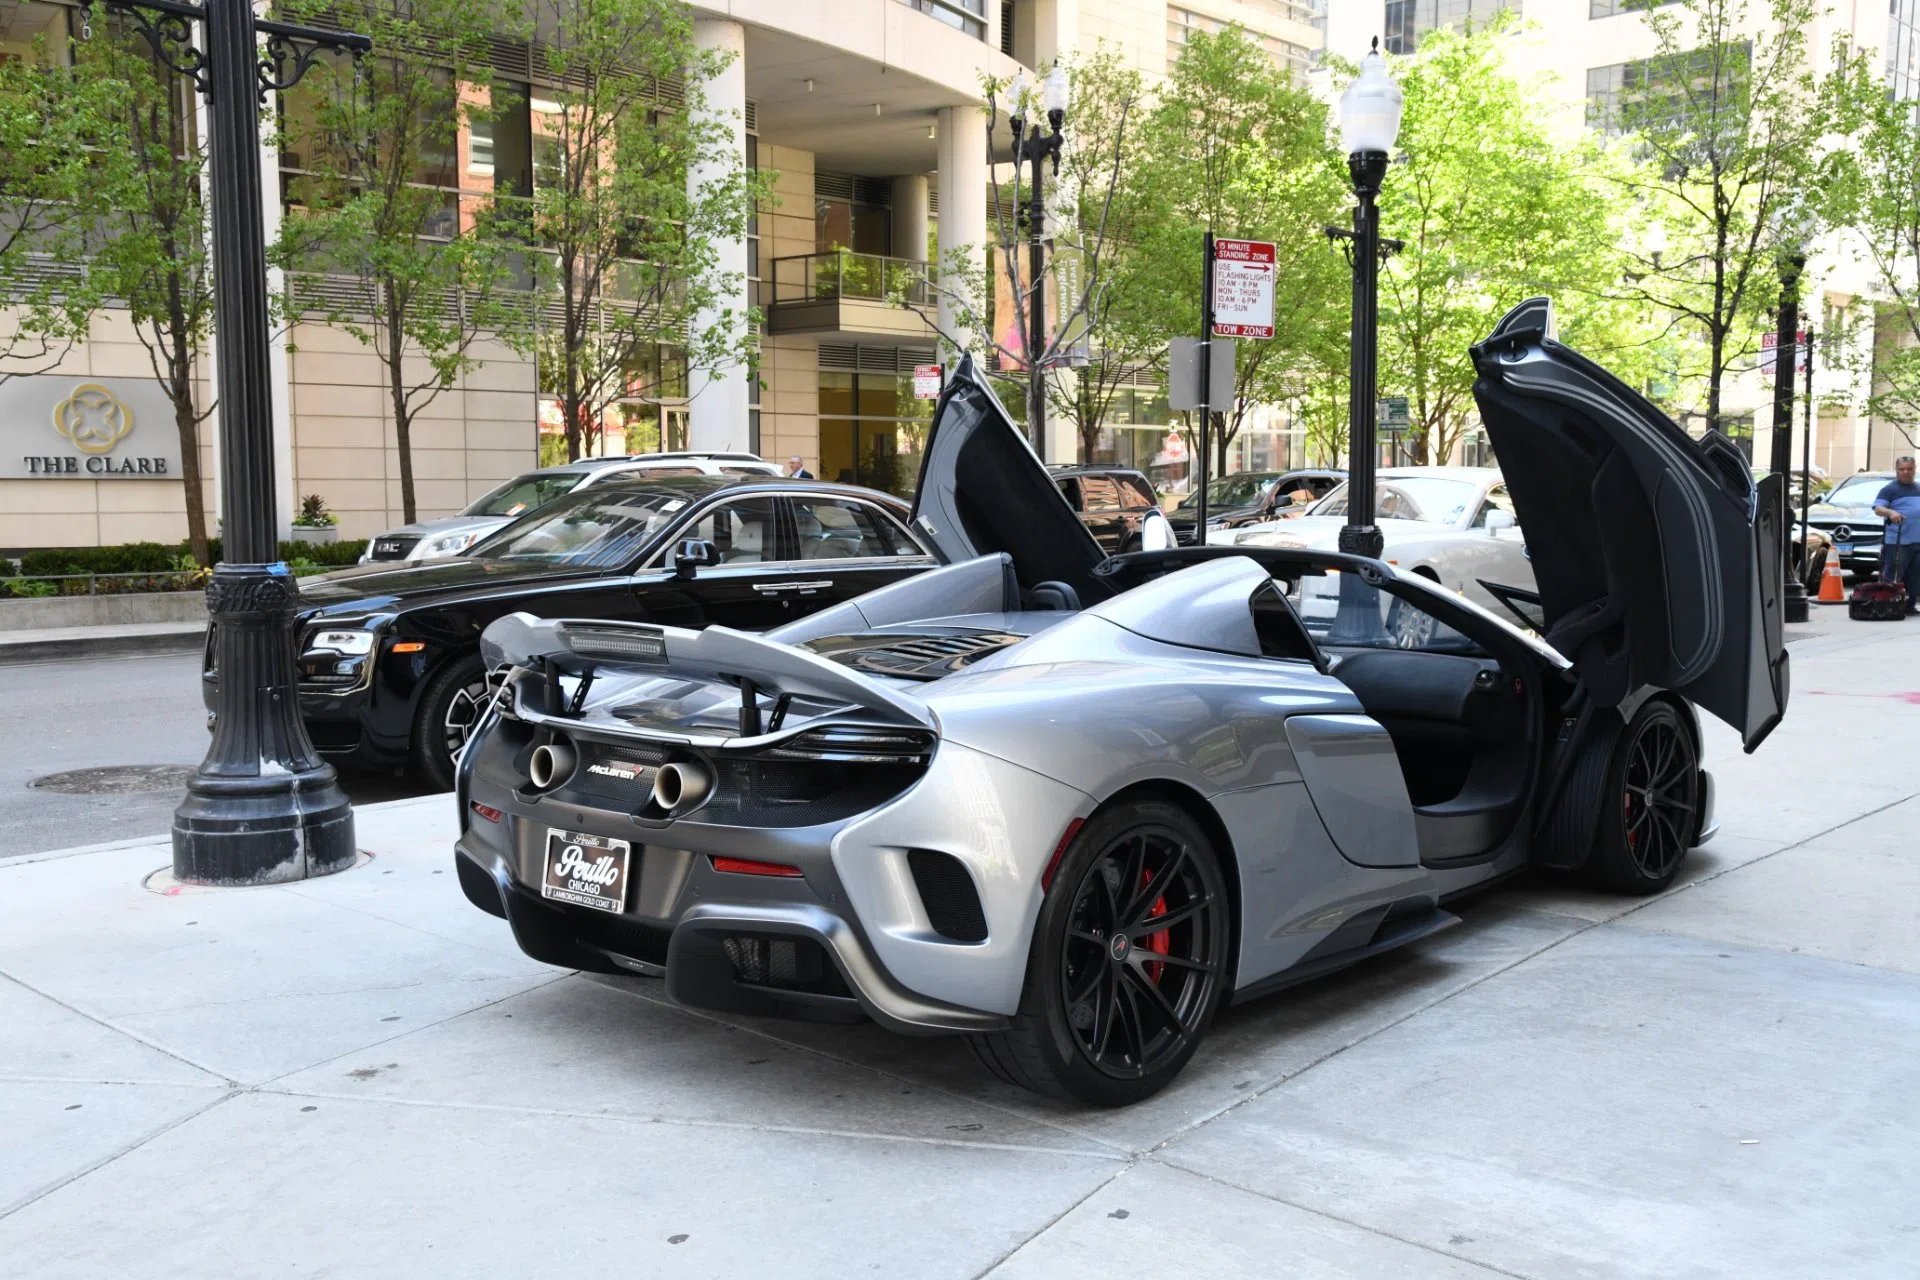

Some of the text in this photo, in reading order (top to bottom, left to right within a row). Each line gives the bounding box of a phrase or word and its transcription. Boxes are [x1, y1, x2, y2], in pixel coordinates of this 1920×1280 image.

[1227, 243, 1250, 251] MINUTE
[1219, 251, 1268, 261] STANDING ZONE
[1218, 271, 1272, 282] FLASHING LIGHTS
[1217, 287, 1233, 295] MON
[1240, 289, 1261, 297] THURS
[1217, 324, 1268, 336] TOW ZONE
[24, 456, 168, 474] THE CLARE
[587, 764, 635, 780] McLaren
[573, 833, 600, 846] Perillo
[554, 845, 619, 886] Perillo
[568, 878, 600, 895] CHICAGO
[552, 890, 610, 909] LAMBORGHINI GOLD COAST
